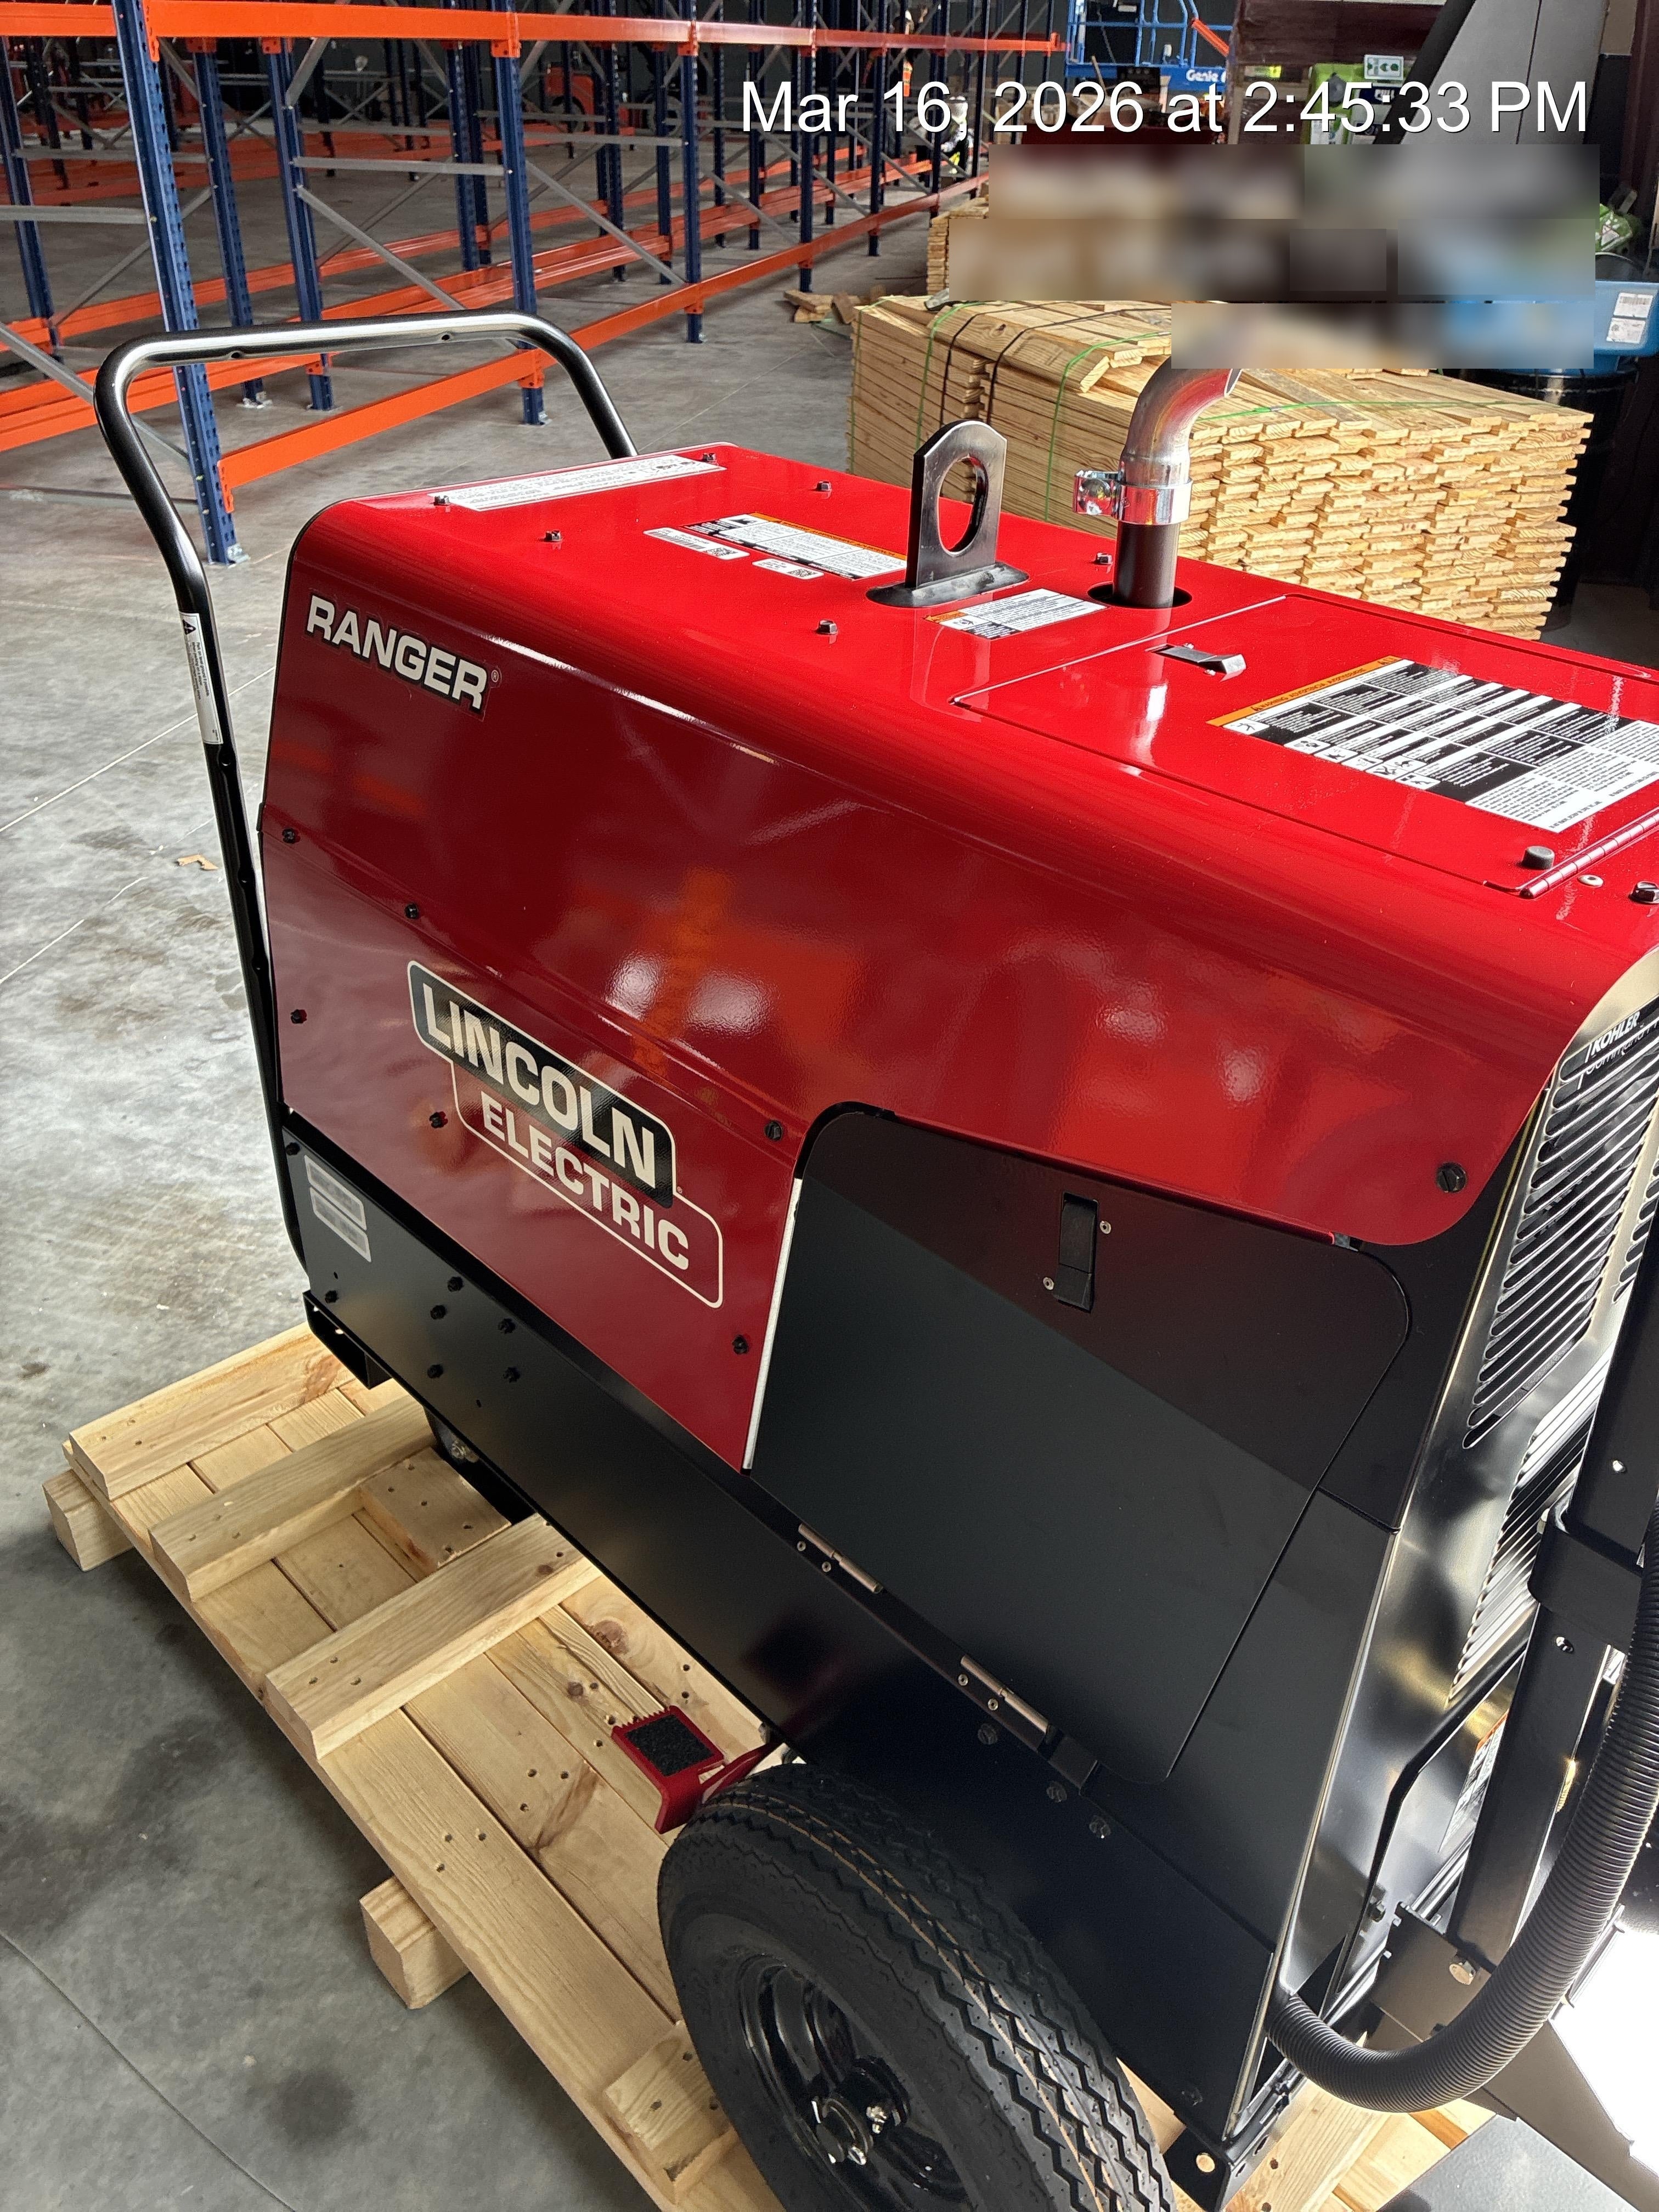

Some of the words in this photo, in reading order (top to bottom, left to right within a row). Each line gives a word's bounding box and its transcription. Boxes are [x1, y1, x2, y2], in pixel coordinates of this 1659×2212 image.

[1186, 69, 1218, 82] Genie
[307, 595, 488, 710] RANGER
[422, 983, 656, 1189] LINCOLN
[1591, 1011, 1640, 1056] KOHLER
[481, 1090, 689, 1271] ELECTRIC
